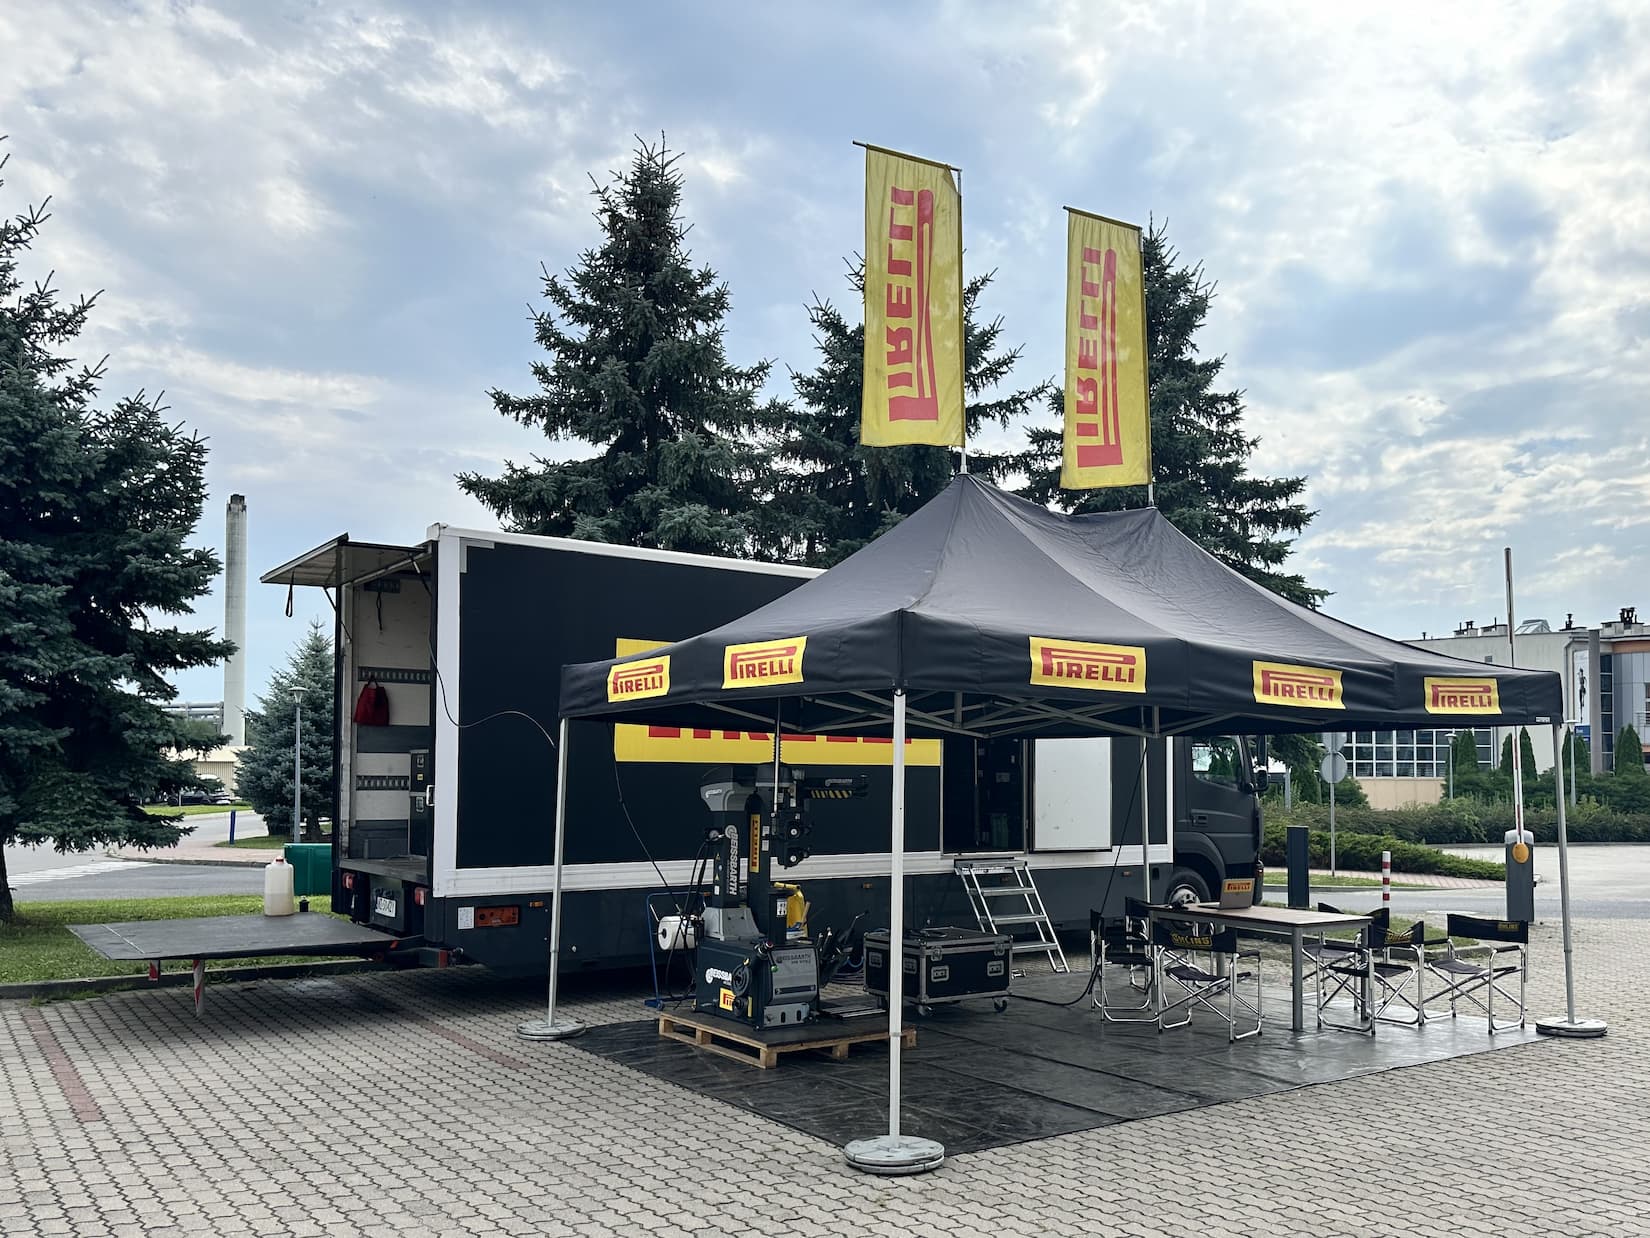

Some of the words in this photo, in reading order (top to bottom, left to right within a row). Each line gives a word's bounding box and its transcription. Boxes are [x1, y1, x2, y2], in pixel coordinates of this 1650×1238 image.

[613, 664, 663, 694] PIRELLI
[731, 646, 797, 680] PIRELLI
[1041, 647, 1137, 683] PIRELLI
[1262, 670, 1334, 701] PIRELLI
[1431, 684, 1492, 708] PIRELLI
[728, 829, 739, 895] BEISSBARTH
